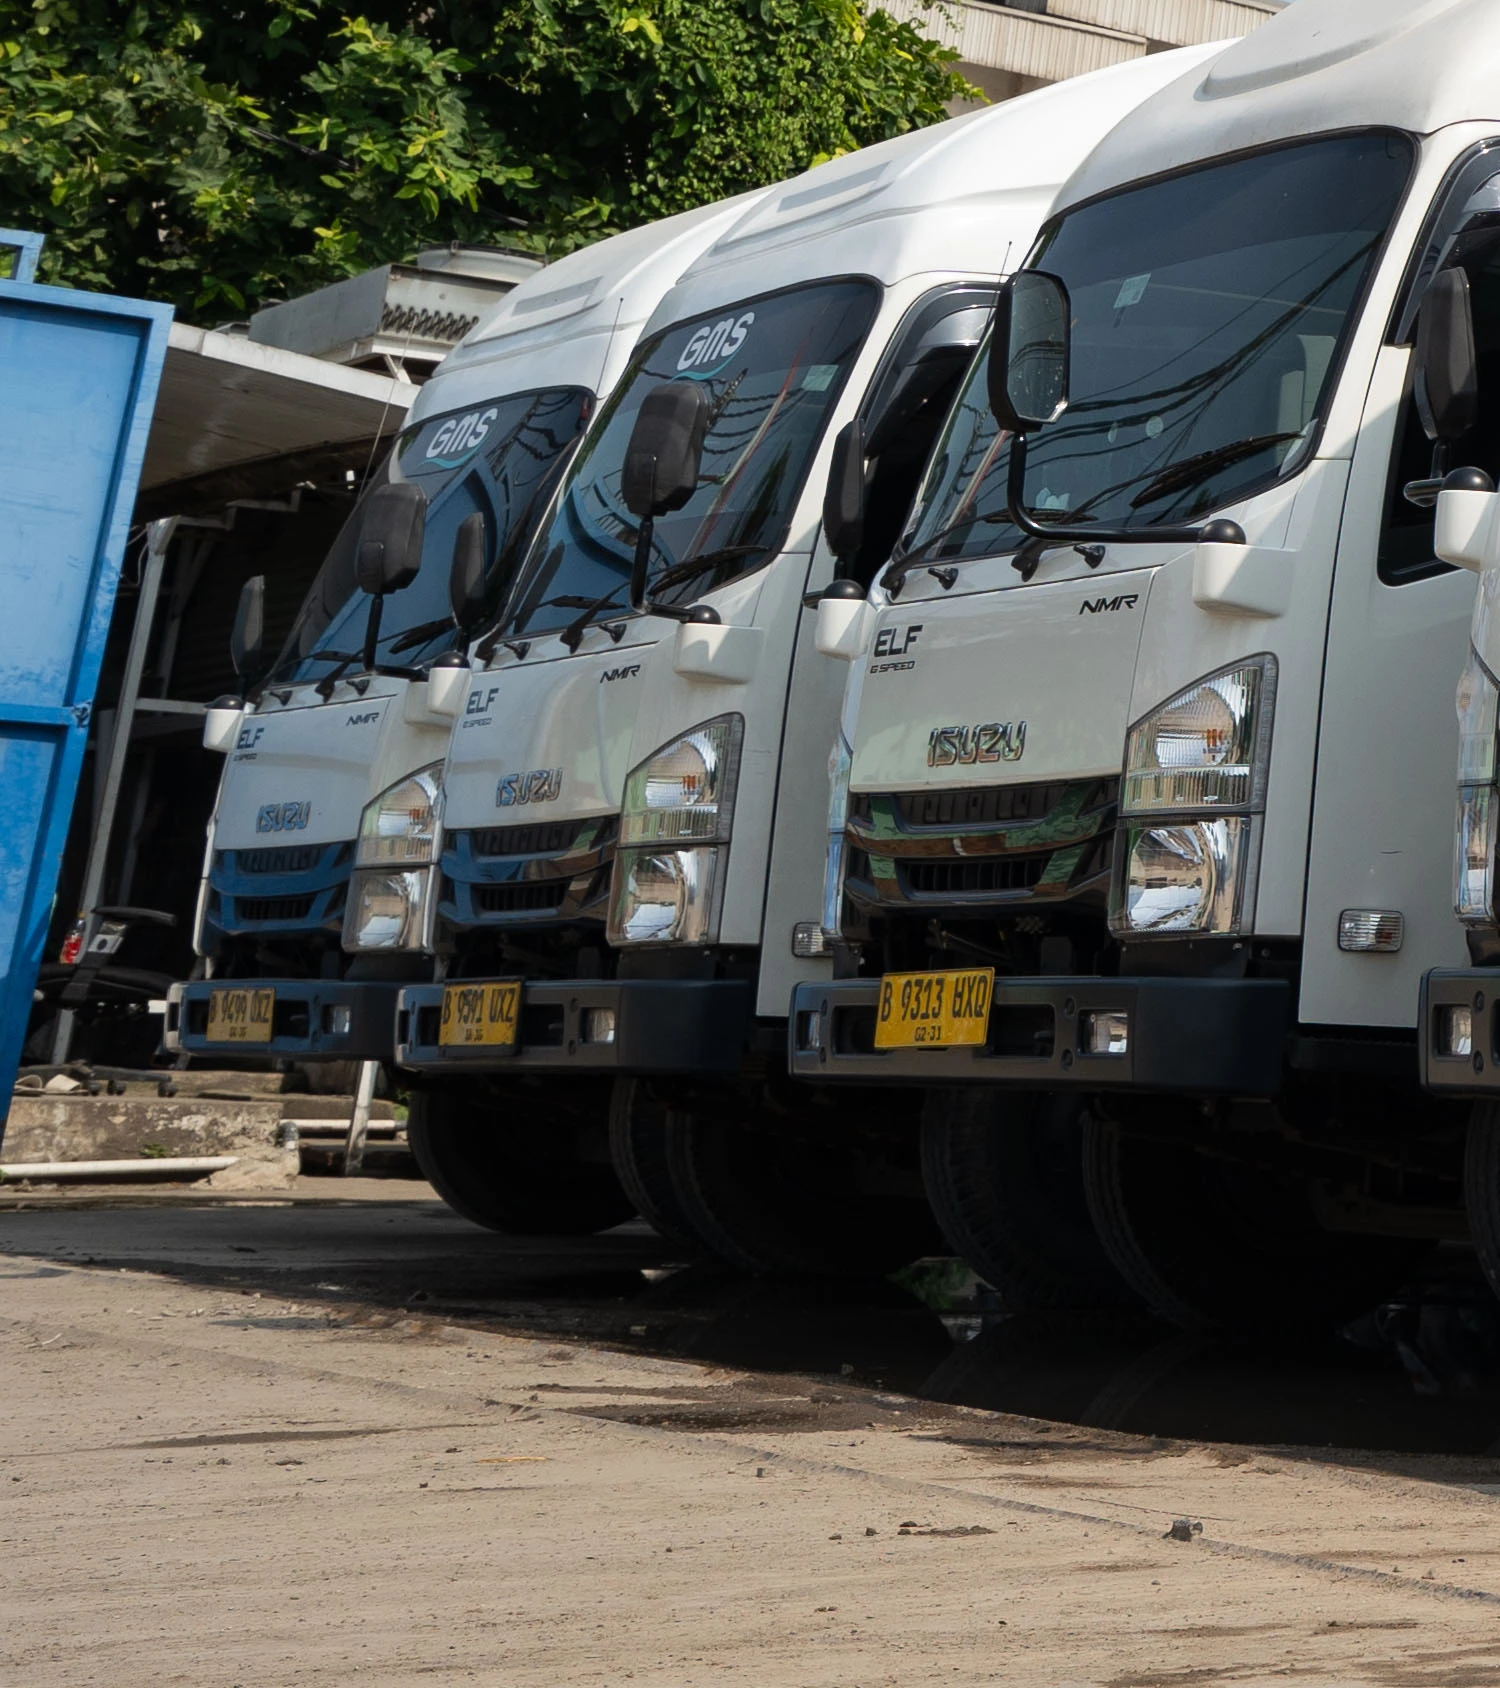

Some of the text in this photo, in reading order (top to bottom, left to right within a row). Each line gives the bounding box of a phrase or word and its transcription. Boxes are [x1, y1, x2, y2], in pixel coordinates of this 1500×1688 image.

[1079, 593, 1139, 615] NMR
[874, 624, 923, 657] ELF
[600, 664, 641, 683] NMR
[879, 660, 915, 673] SPEED
[466, 687, 499, 715] ELF
[237, 727, 265, 749] ELF
[927, 720, 1027, 767] ISUZU
[496, 767, 563, 807] ISUZU
[256, 800, 312, 833] ISUZU
[441, 990, 452, 1025] B
[881, 981, 893, 1022] B
[901, 977, 945, 1021] 9313
